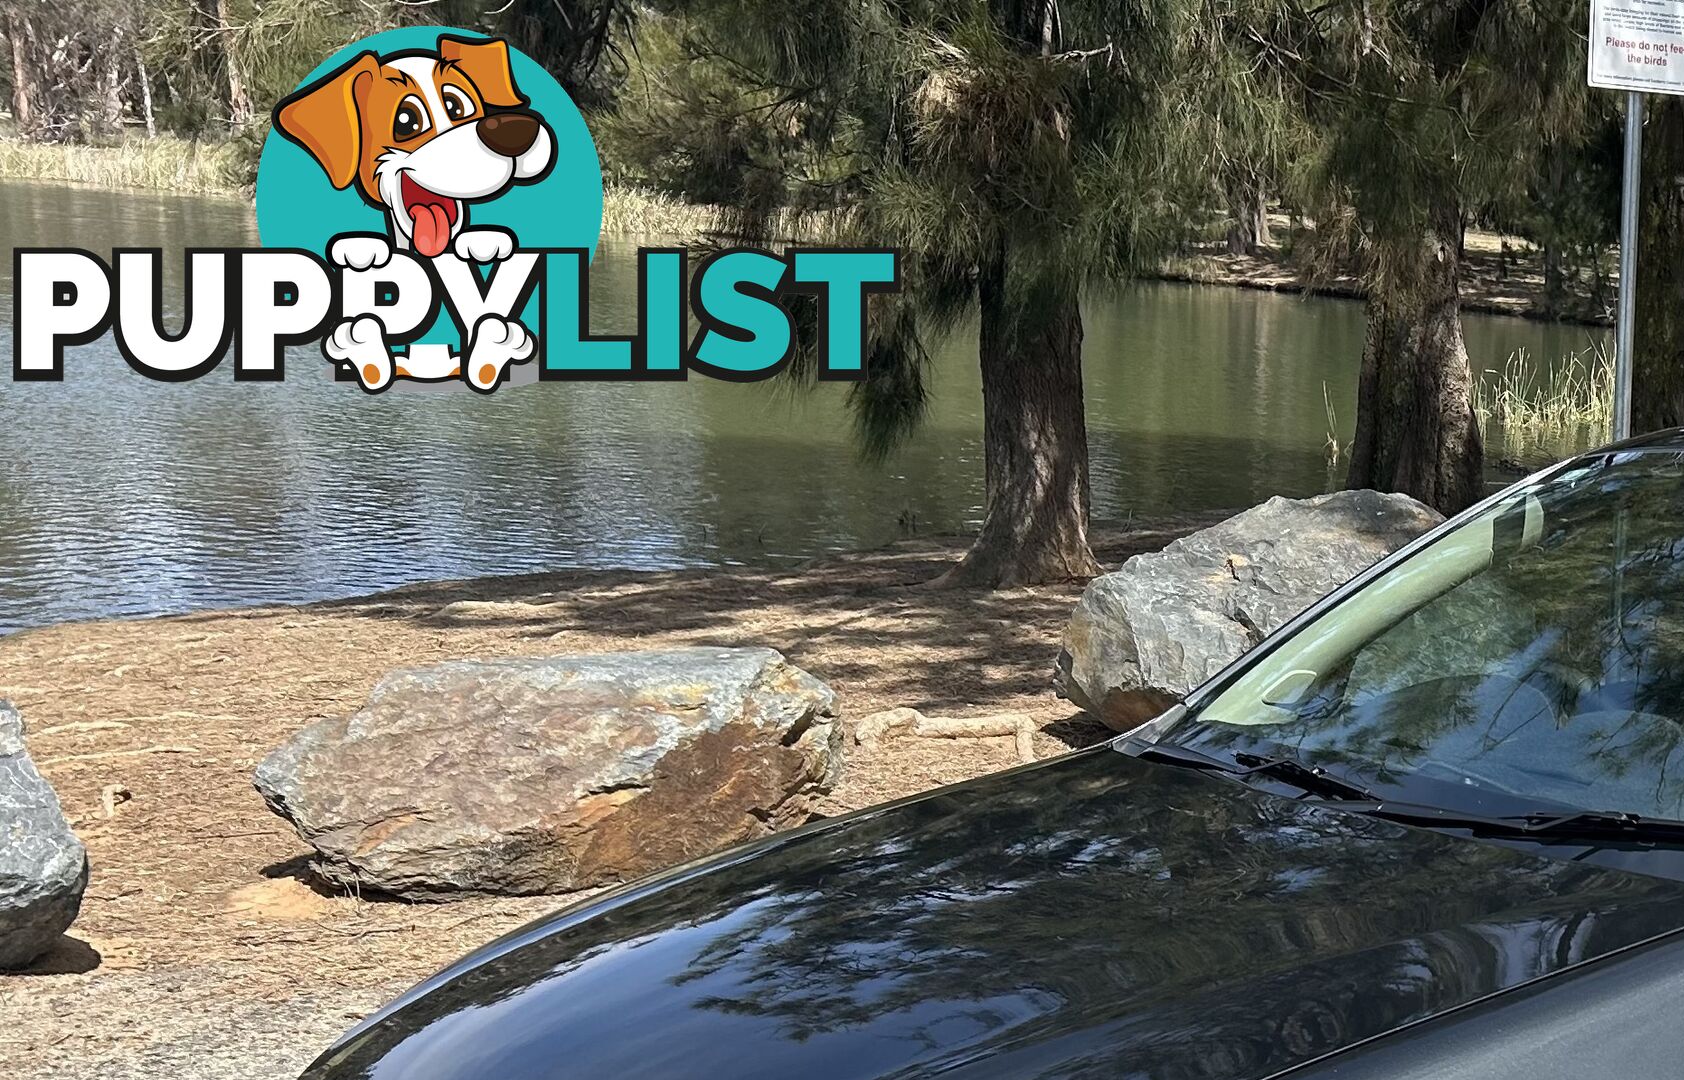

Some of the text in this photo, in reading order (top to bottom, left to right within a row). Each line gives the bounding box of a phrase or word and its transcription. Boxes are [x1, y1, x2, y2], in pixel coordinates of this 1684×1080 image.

[1606, 36, 1636, 49] Please
[1638, 40, 1650, 50] do
[1653, 42, 1668, 53] not
[1627, 53, 1667, 66] the birds
